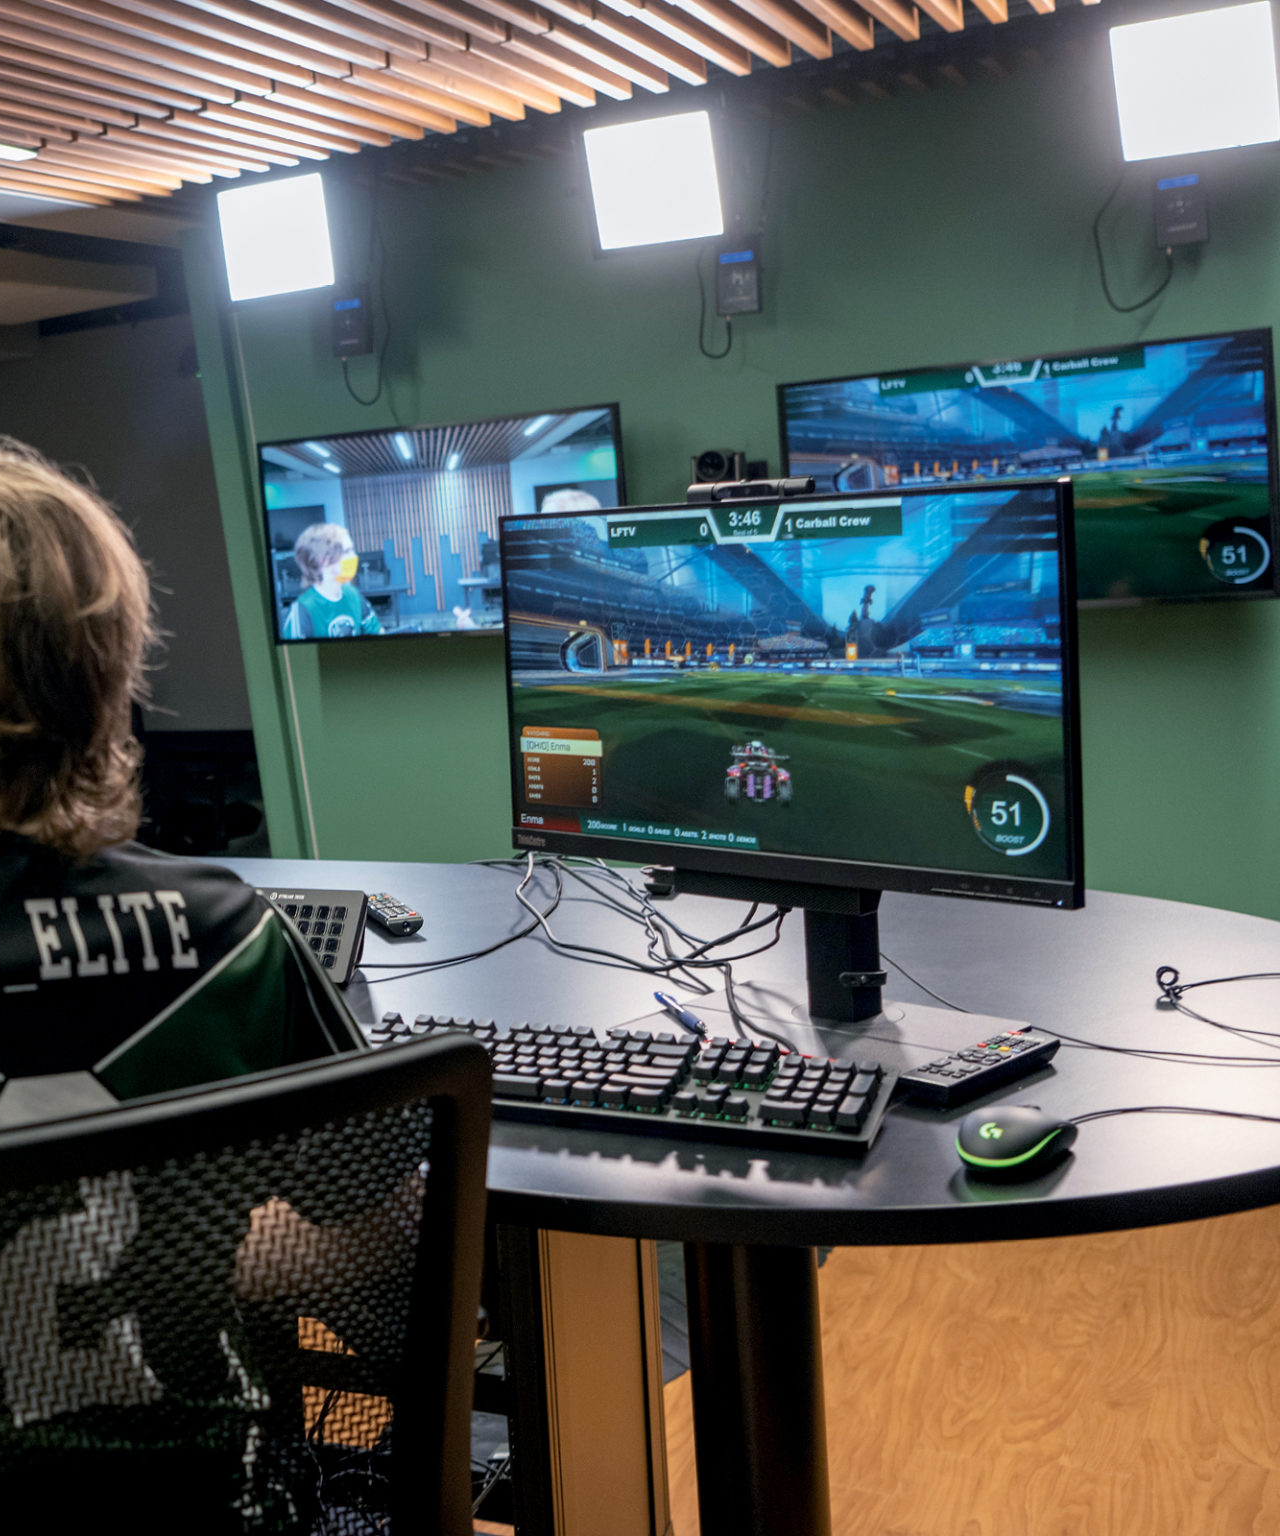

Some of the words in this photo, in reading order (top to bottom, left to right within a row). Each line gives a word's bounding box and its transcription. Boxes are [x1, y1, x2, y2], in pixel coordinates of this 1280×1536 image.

[1052, 359, 1089, 371] Carball
[1091, 357, 1119, 367] Crew
[728, 510, 761, 528] 3:46
[784, 518, 793, 533] 1
[795, 516, 837, 529] Carball
[839, 515, 871, 527] Crew
[610, 526, 636, 538] LFTV
[699, 523, 708, 537] 0
[1222, 544, 1247, 565] 51
[550, 742, 571, 752] Enma
[583, 758, 596, 766] 200
[520, 813, 544, 825] Enma
[991, 800, 1021, 827] 51
[701, 830, 707, 840] 2
[995, 834, 1025, 844] BOOST
